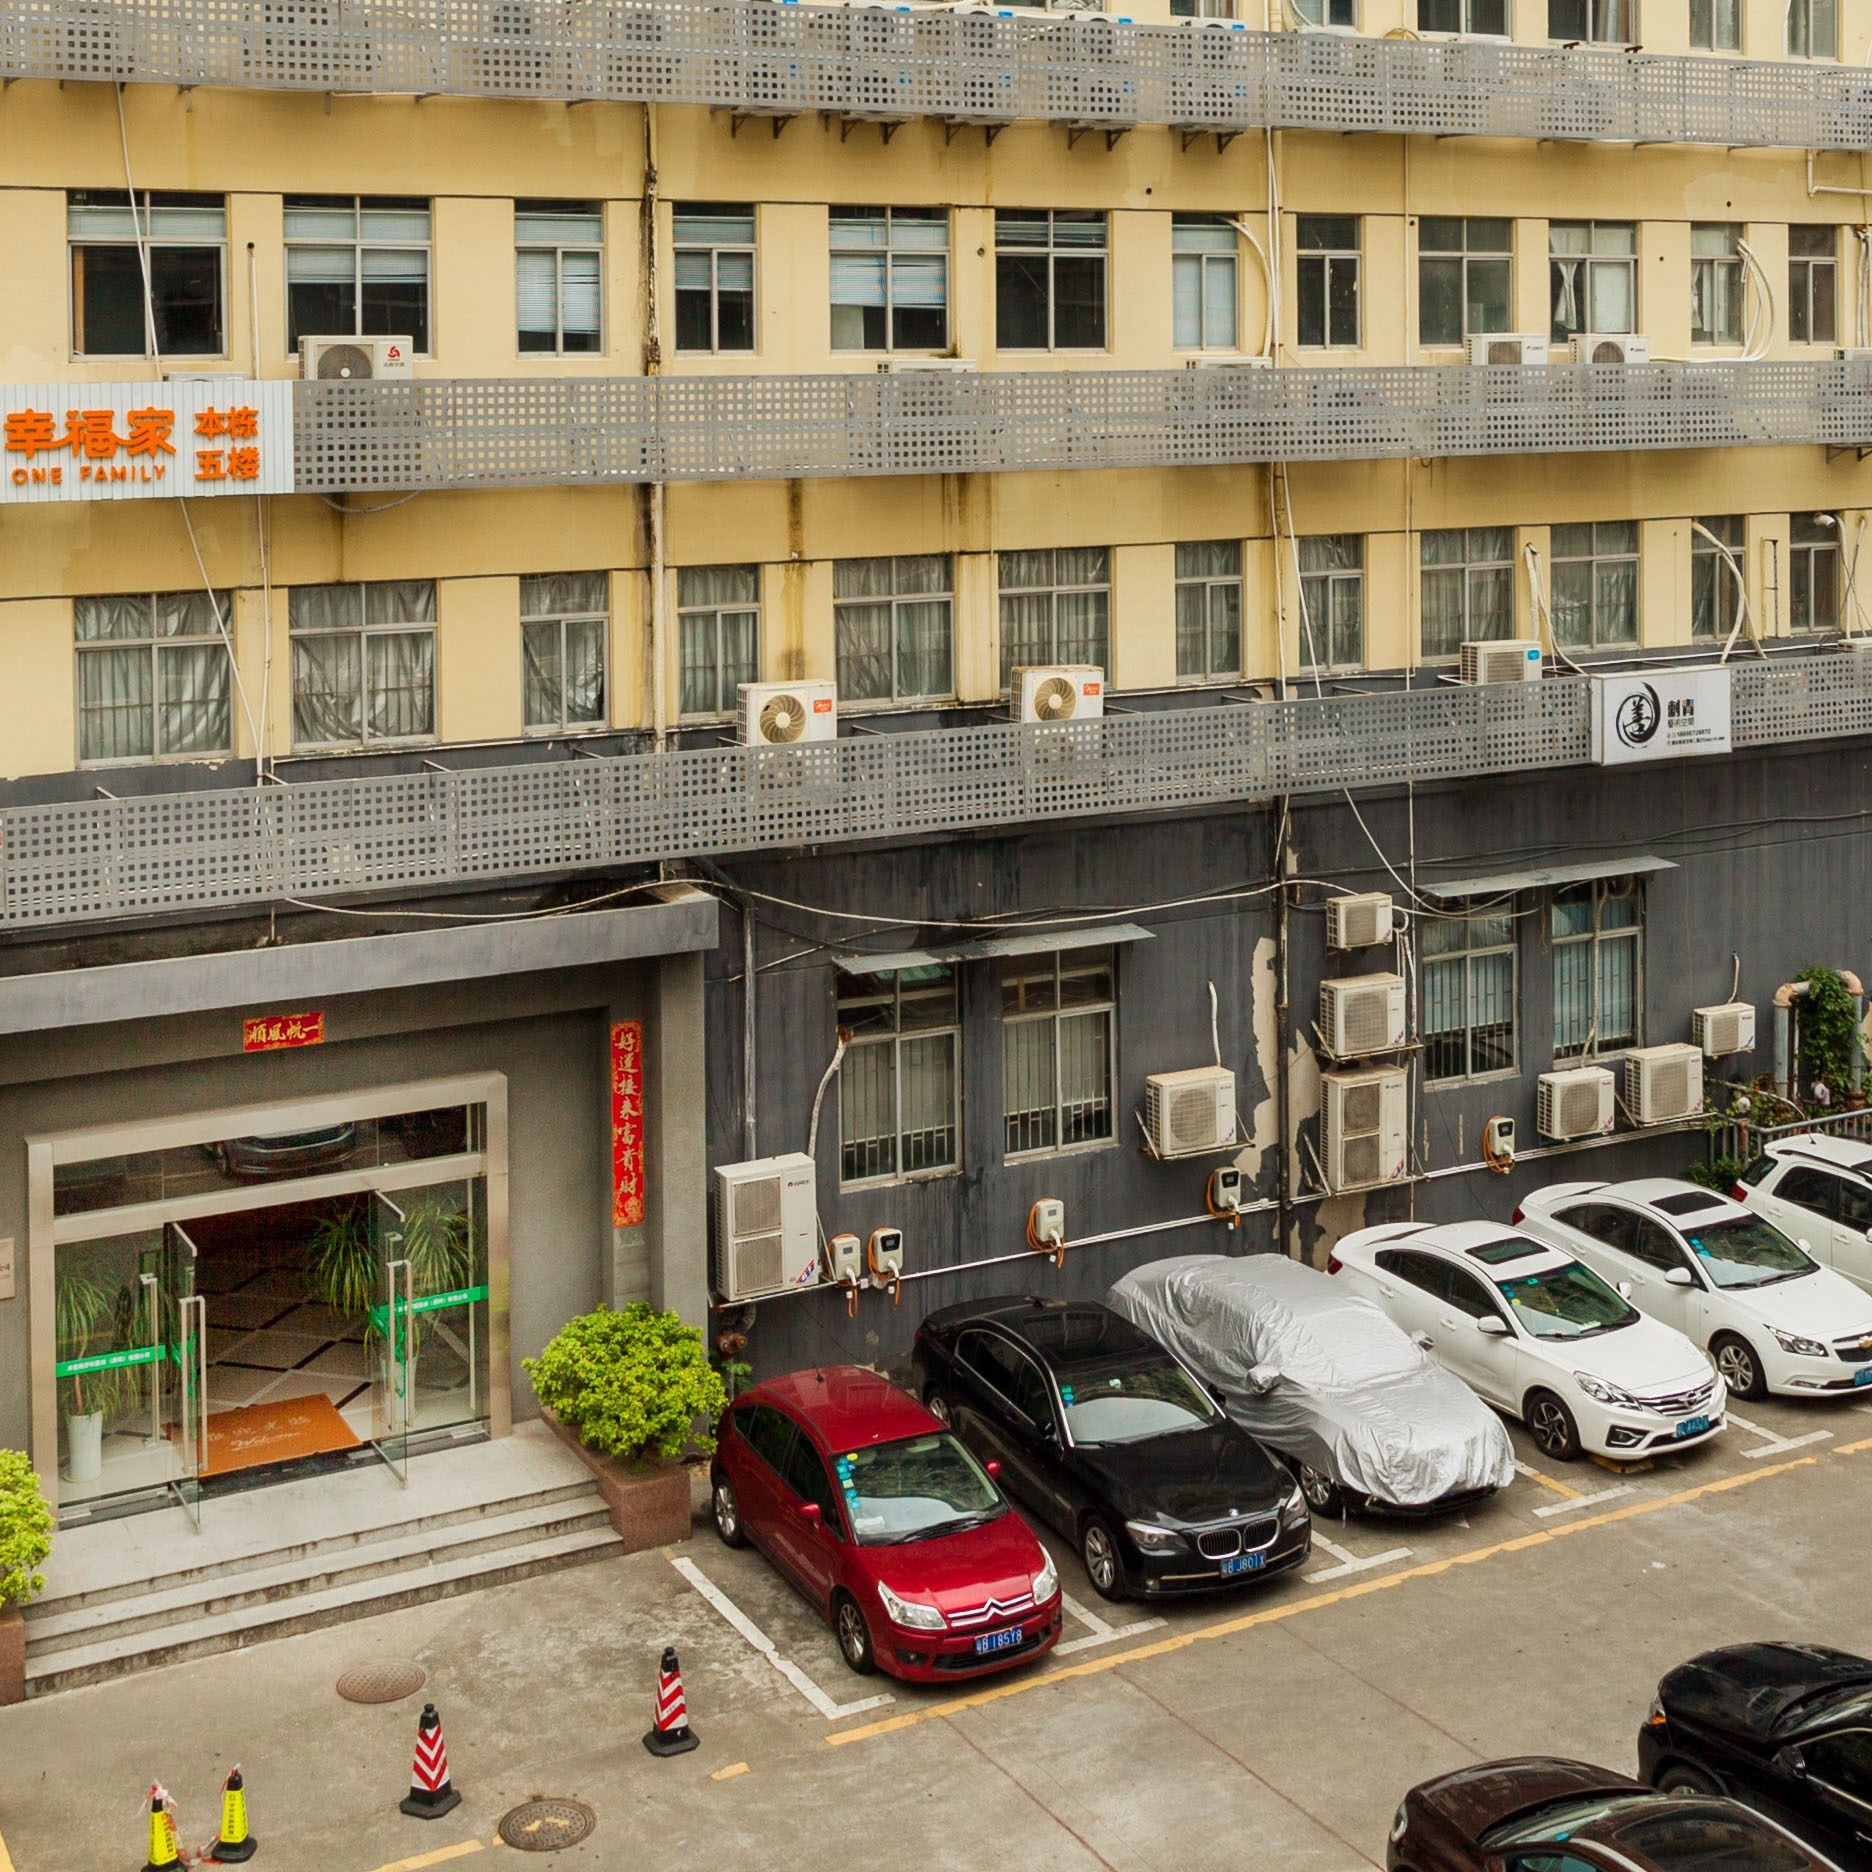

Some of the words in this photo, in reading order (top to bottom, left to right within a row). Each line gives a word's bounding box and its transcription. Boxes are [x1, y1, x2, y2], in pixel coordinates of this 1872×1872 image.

[3, 406, 177, 459] 幸福家
[194, 406, 259, 440] 本栋
[12, 467, 63, 485] ONE
[80, 464, 167, 483] FAMILY
[194, 447, 260, 481] 五楼
